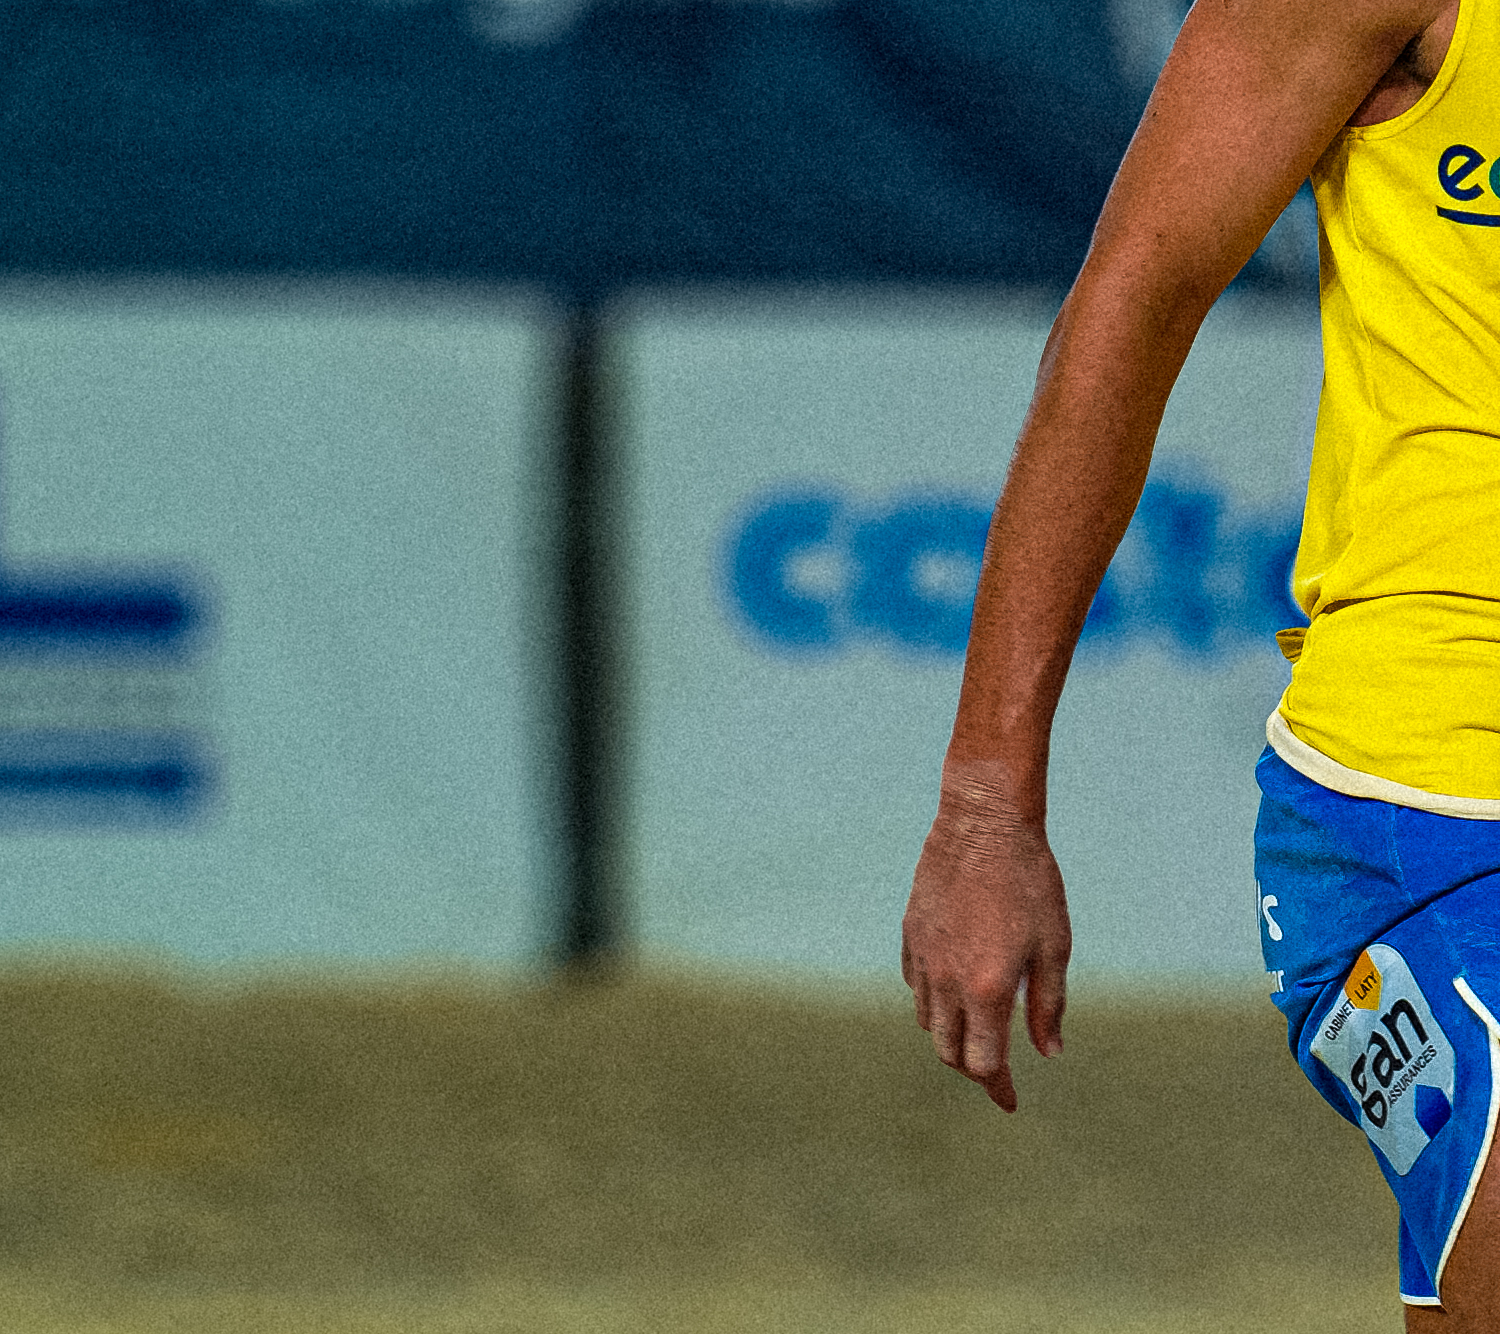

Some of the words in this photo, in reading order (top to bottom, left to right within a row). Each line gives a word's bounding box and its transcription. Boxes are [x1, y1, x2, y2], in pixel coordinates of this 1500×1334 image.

[1353, 971, 1378, 1001] LATY
[1323, 997, 1357, 1042] CABINET
[1350, 997, 1430, 1130] gan
[1387, 1044, 1438, 1109] ASSURANCES
